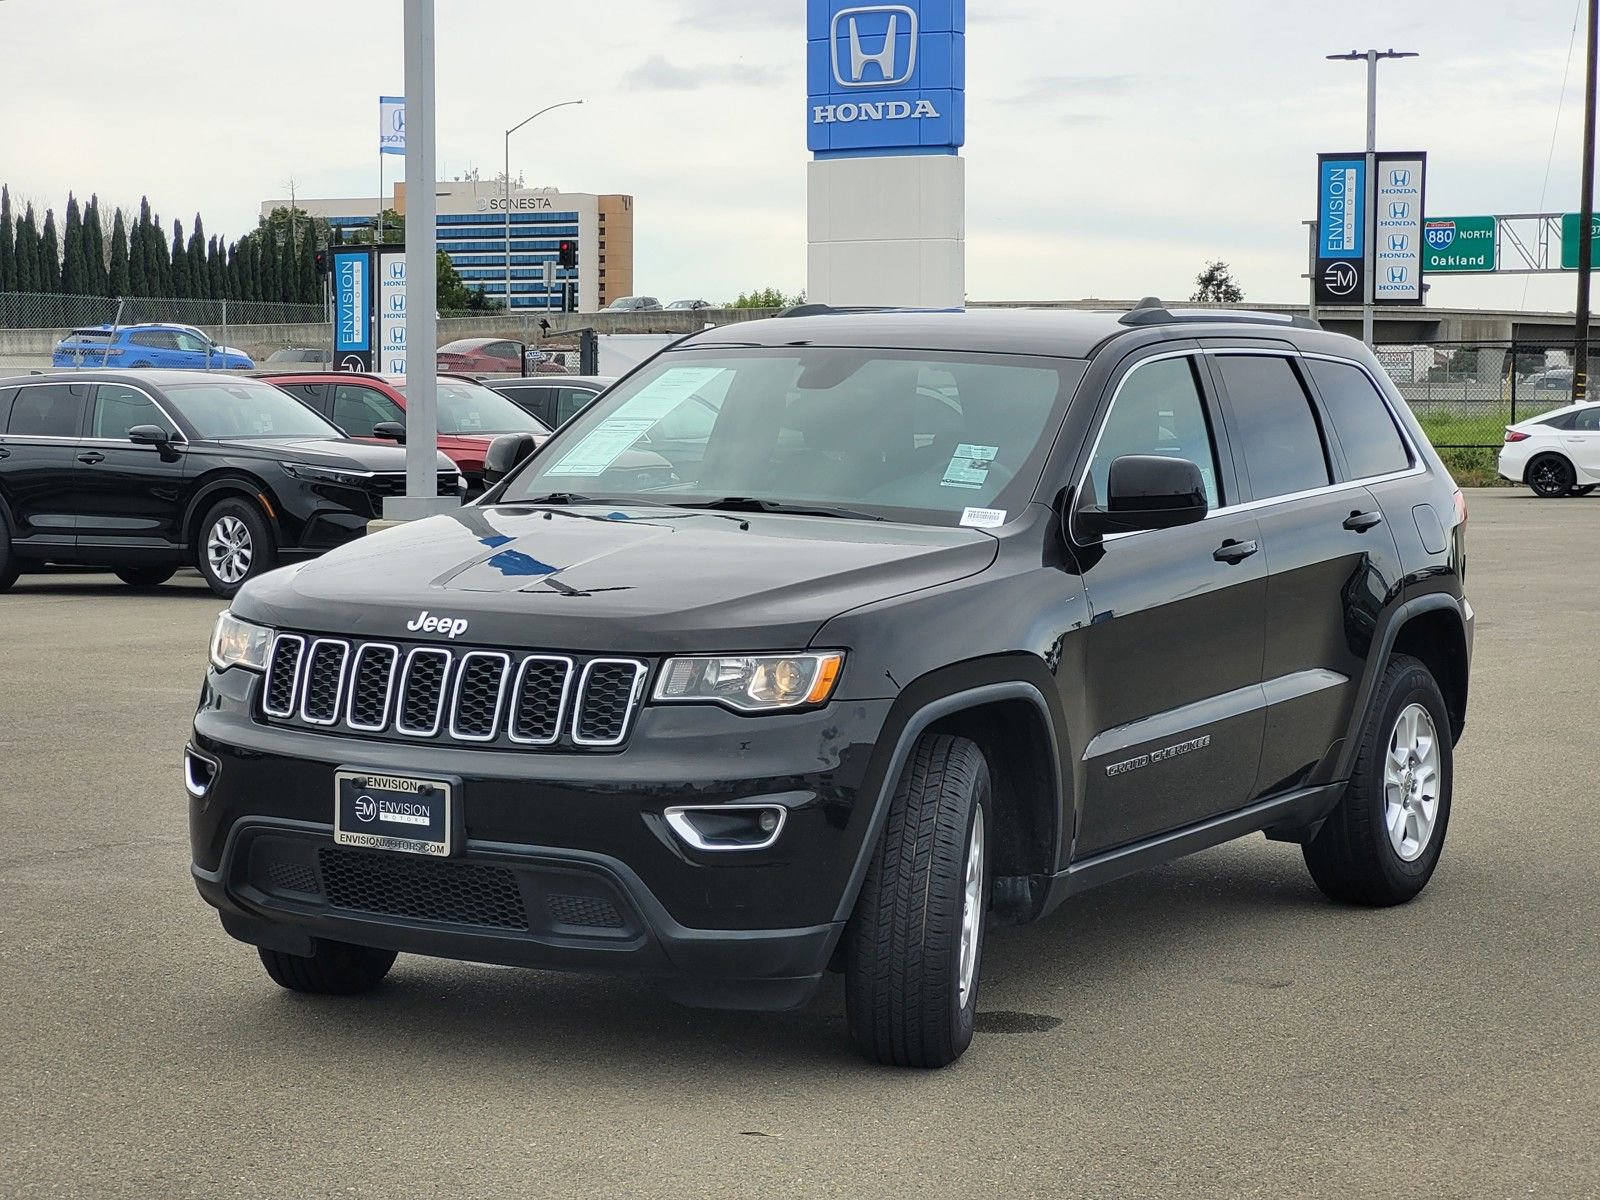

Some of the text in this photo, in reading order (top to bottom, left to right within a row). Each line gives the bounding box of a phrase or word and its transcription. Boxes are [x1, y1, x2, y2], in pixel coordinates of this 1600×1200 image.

[813, 100, 940, 124] HONDA
[489, 198, 552, 210] SONESTA
[1328, 168, 1344, 251] ENVISION
[1346, 176, 1354, 244] MOTORS
[1429, 231, 1452, 243] 880
[1459, 230, 1493, 239] NORTH
[1431, 255, 1485, 266] Oakland
[342, 261, 353, 344] ENVISION
[407, 610, 468, 639] Jeep
[1106, 734, 1211, 777] GRAND CHEROKEE
[367, 776, 417, 792] ENVISION
[379, 800, 430, 817] ENVISION
[340, 833, 445, 854] ENVISIONMOTORS.COM
